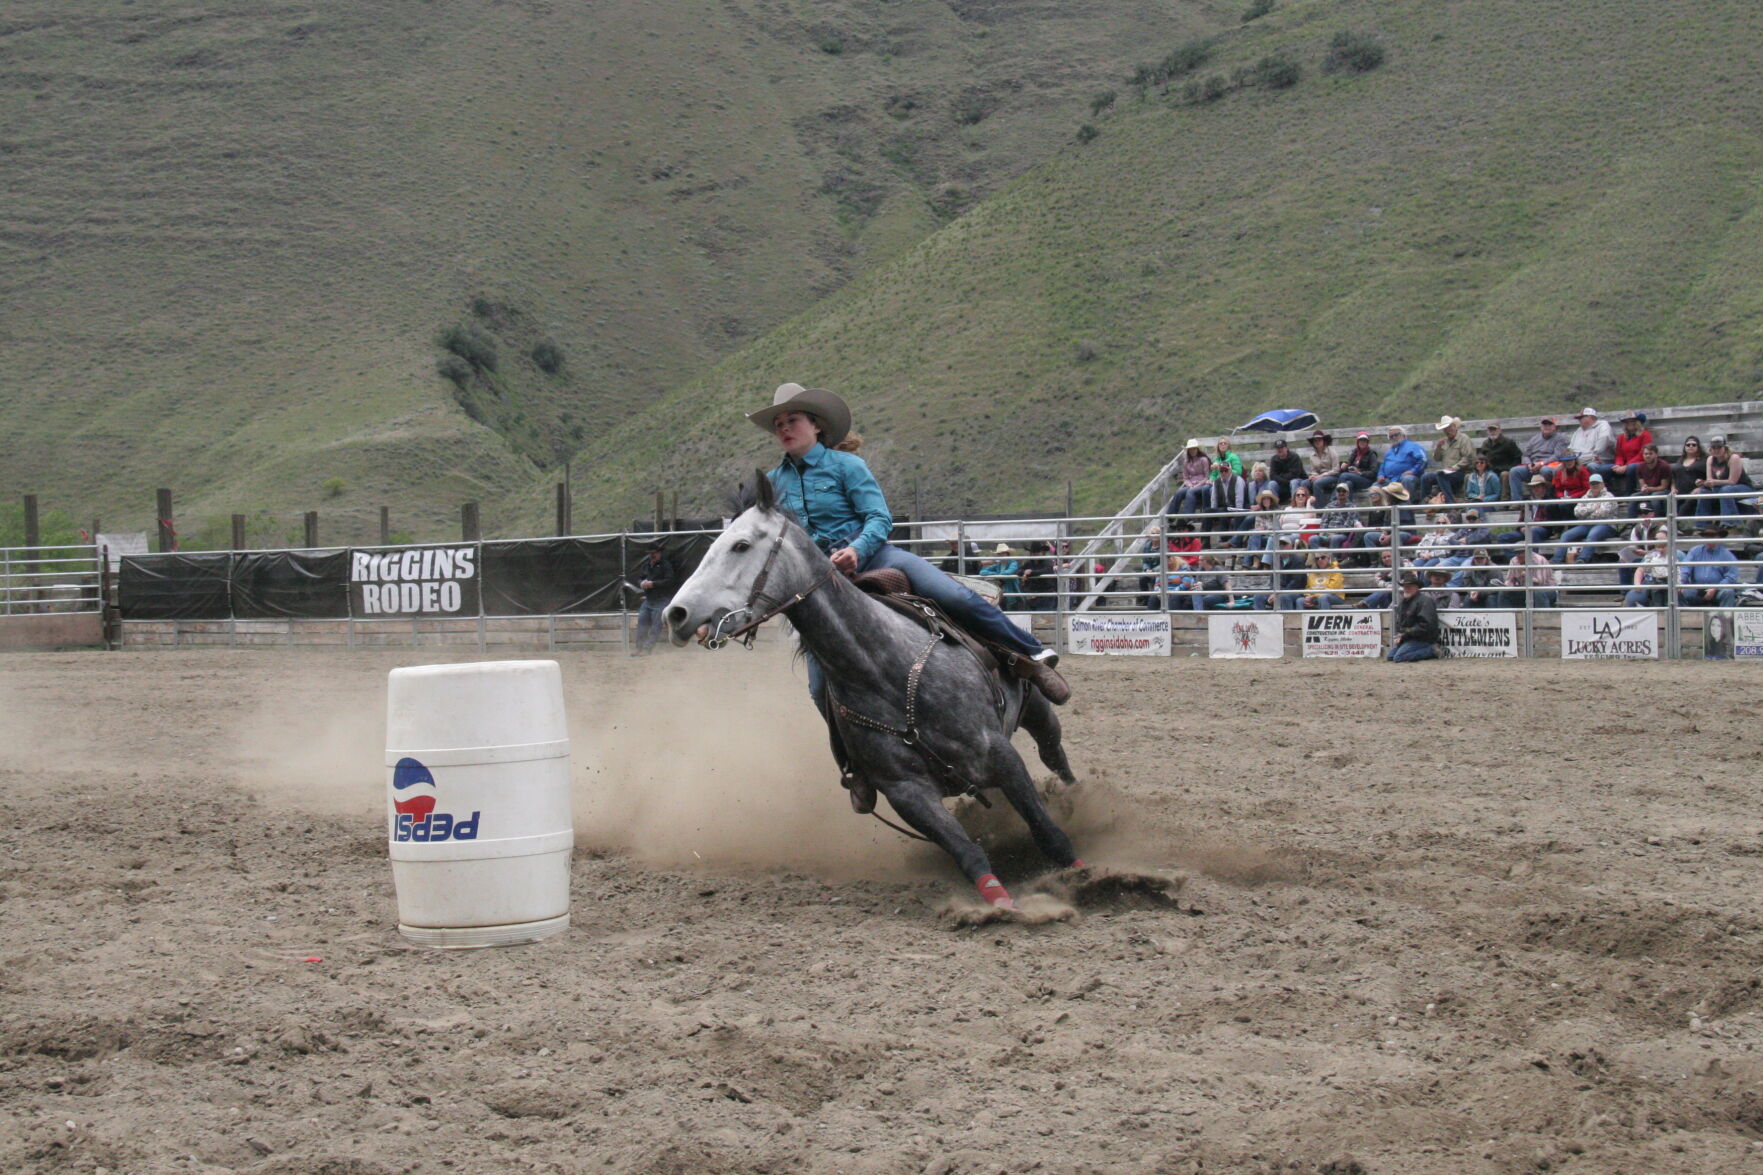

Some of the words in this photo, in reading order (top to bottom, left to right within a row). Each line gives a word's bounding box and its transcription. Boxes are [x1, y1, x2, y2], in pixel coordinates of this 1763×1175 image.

[352, 547, 475, 582] RIGGINS
[362, 581, 461, 614] RODEO
[1072, 619, 1091, 632] Salmon
[1092, 618, 1105, 632] River
[1106, 618, 1132, 632] Chamber
[1132, 618, 1139, 632] of
[1139, 618, 1168, 632] Commerce
[1308, 615, 1353, 630] VERN
[1454, 616, 1490, 627] Kate's
[1737, 612, 1763, 621] ABBE
[1091, 635, 1150, 652] rigginsidaho.com
[1439, 628, 1511, 647] ATTLEMENS
[1568, 639, 1608, 655] LUCKY
[1610, 639, 1652, 656] ACRES
[394, 811, 480, 842] PEPSI
